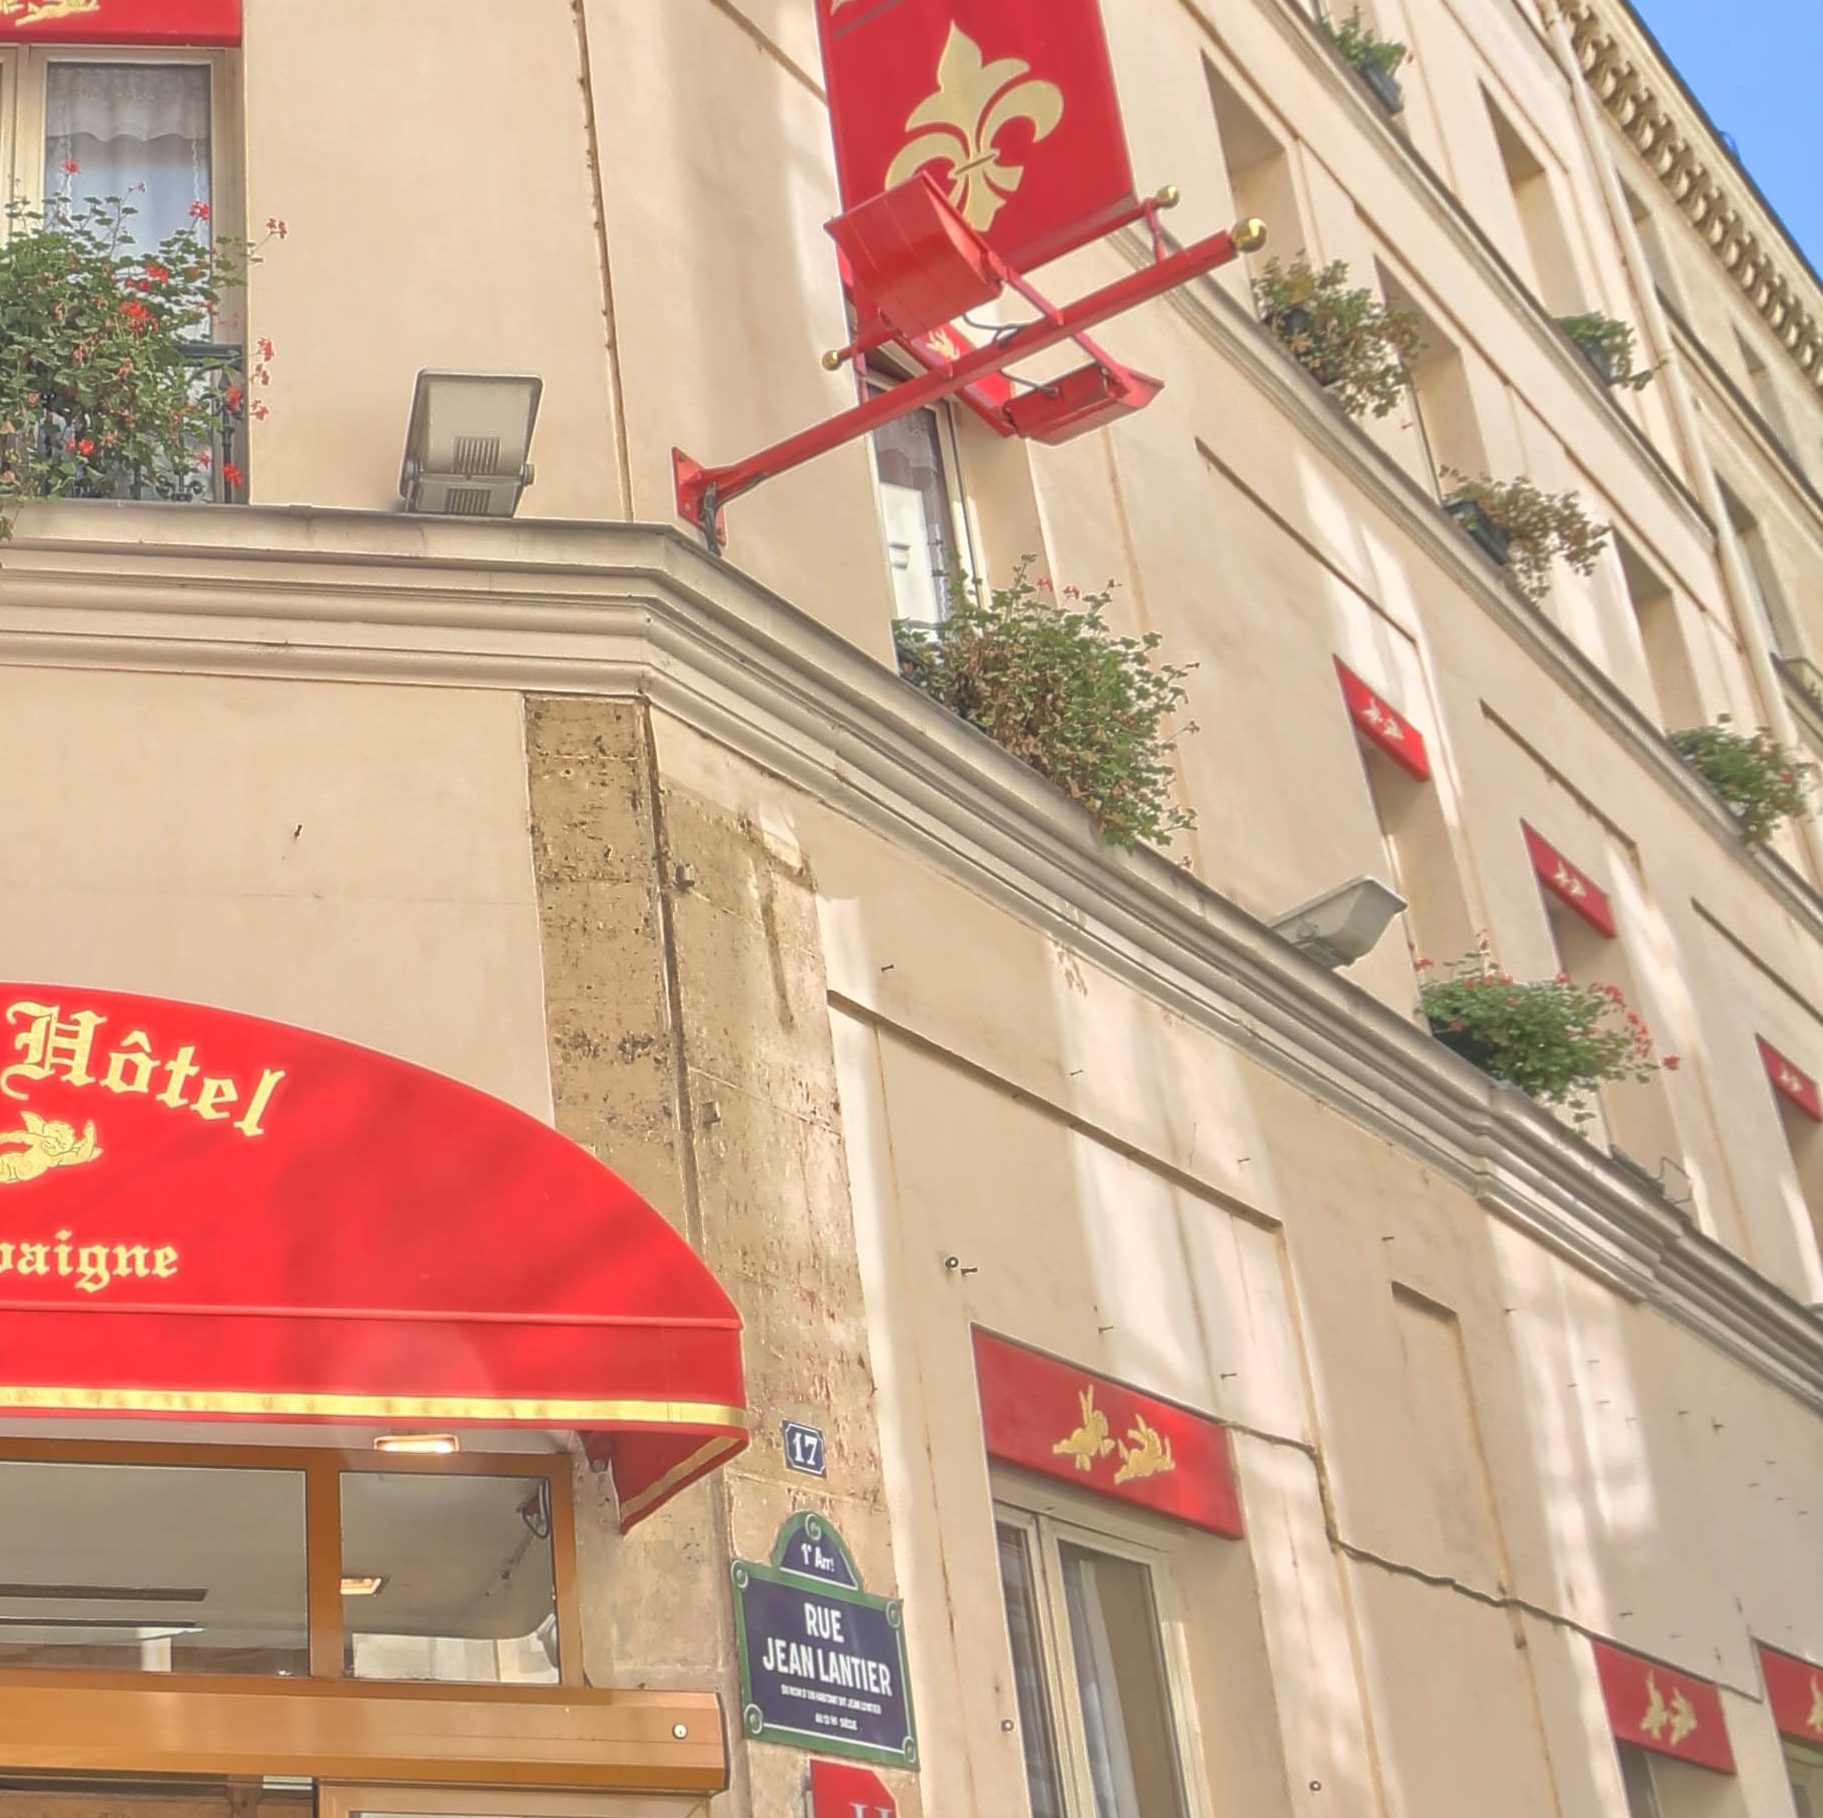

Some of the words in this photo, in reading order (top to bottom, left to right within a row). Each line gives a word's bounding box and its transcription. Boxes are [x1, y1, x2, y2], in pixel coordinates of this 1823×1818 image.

[0, 1000, 285, 1137] Hôtel
[793, 1432, 818, 1466] 17
[804, 1601, 845, 1644] RUE
[762, 1637, 816, 1680] JEAN
[817, 1648, 893, 1697] LANTIER
